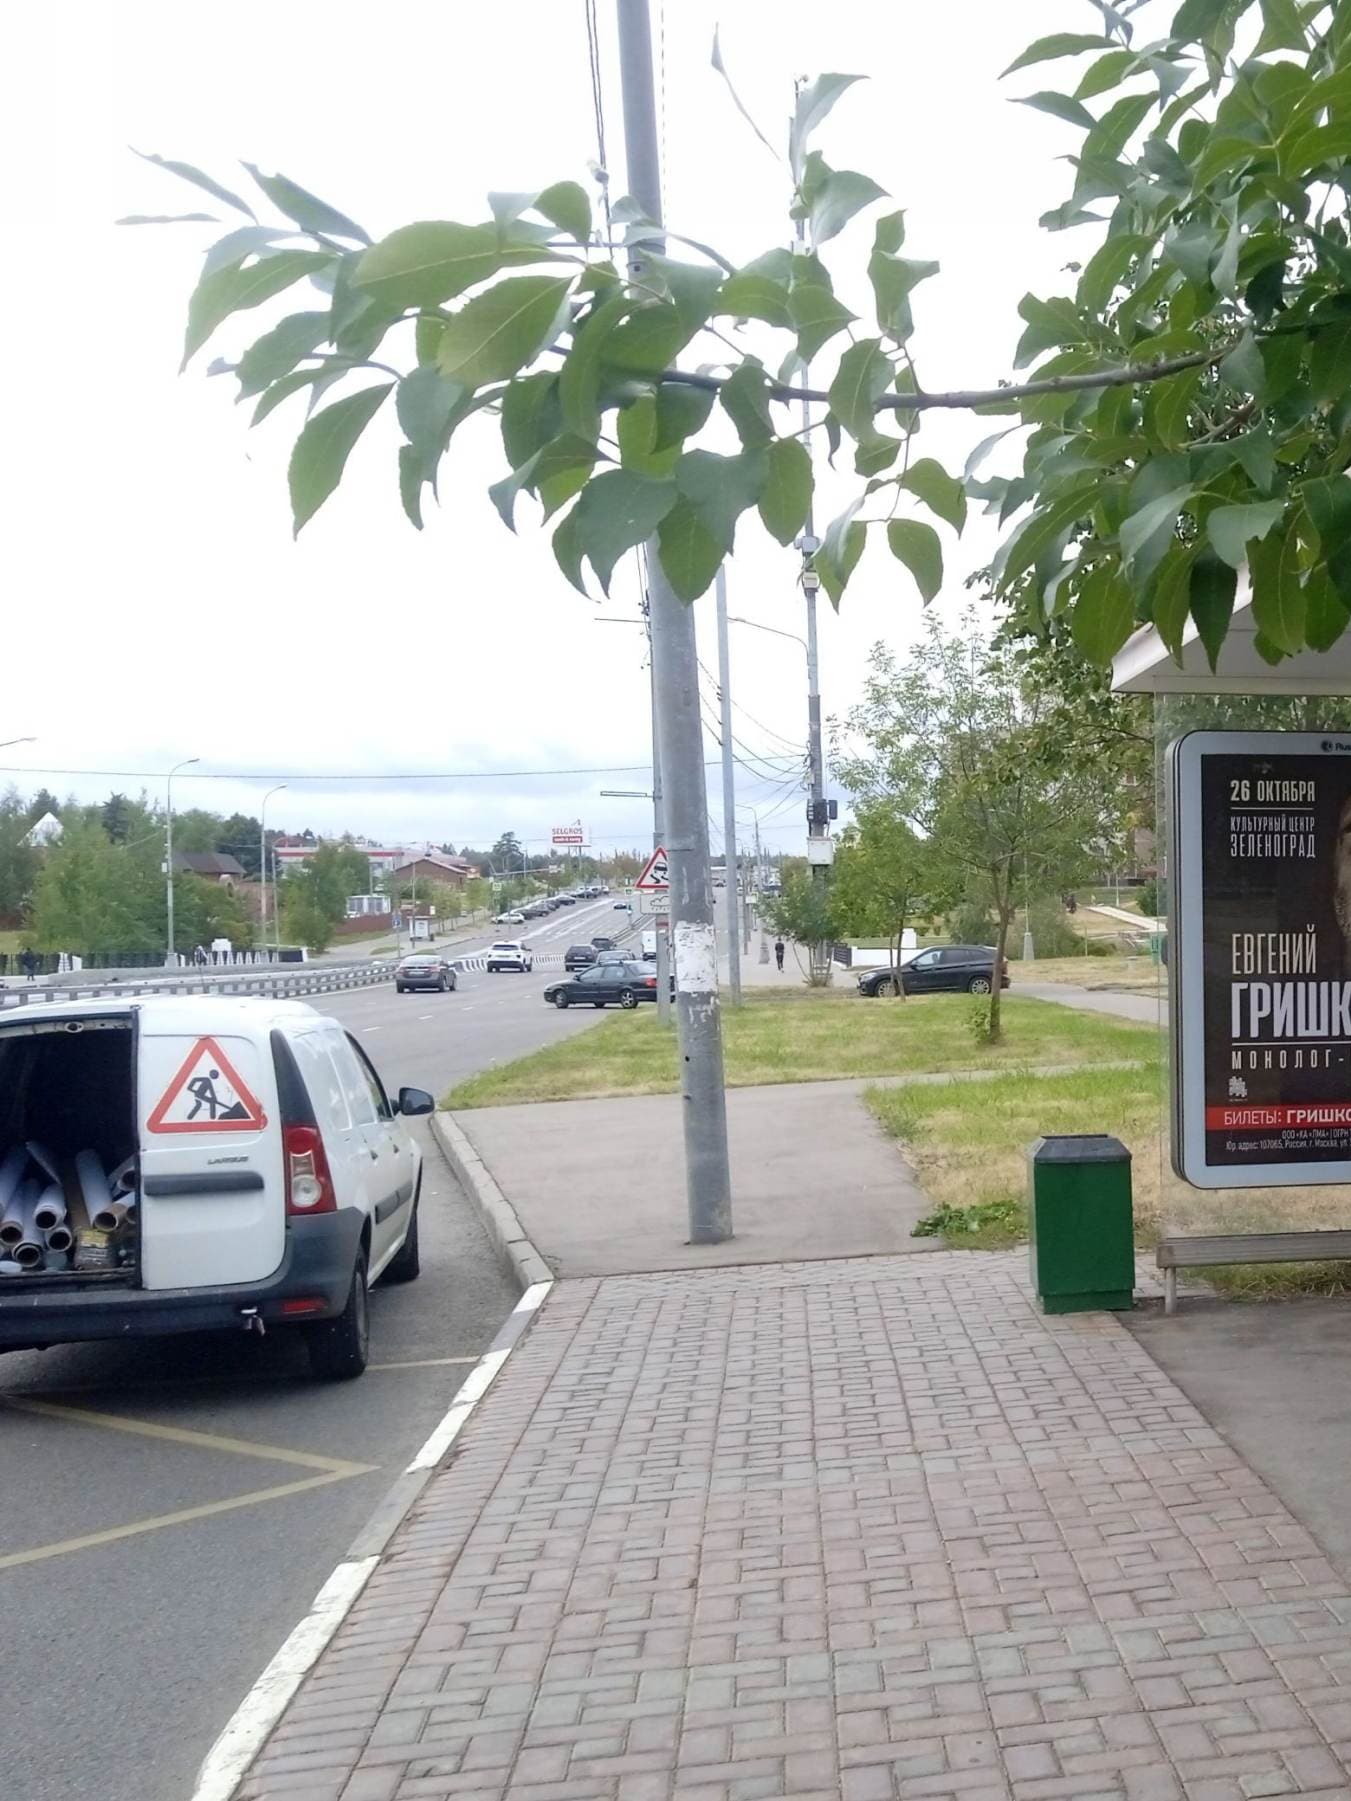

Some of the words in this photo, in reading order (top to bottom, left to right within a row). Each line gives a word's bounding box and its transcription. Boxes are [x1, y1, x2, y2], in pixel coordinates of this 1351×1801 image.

[1230, 780, 1250, 801] 26
[1257, 780, 1315, 802] ОКТЯБРЯ
[552, 827, 583, 835] SELGROS
[1230, 814, 1286, 832] КУЛЬТУРНЫЙ
[1288, 816, 1315, 832] ЦЕНТР
[1230, 834, 1316, 858] ЗЕЛЕНОГРАД
[1232, 924, 1317, 974] ЕВГЕНИЙ
[1224, 1110, 1281, 1125] БИЛЕТЫ:
